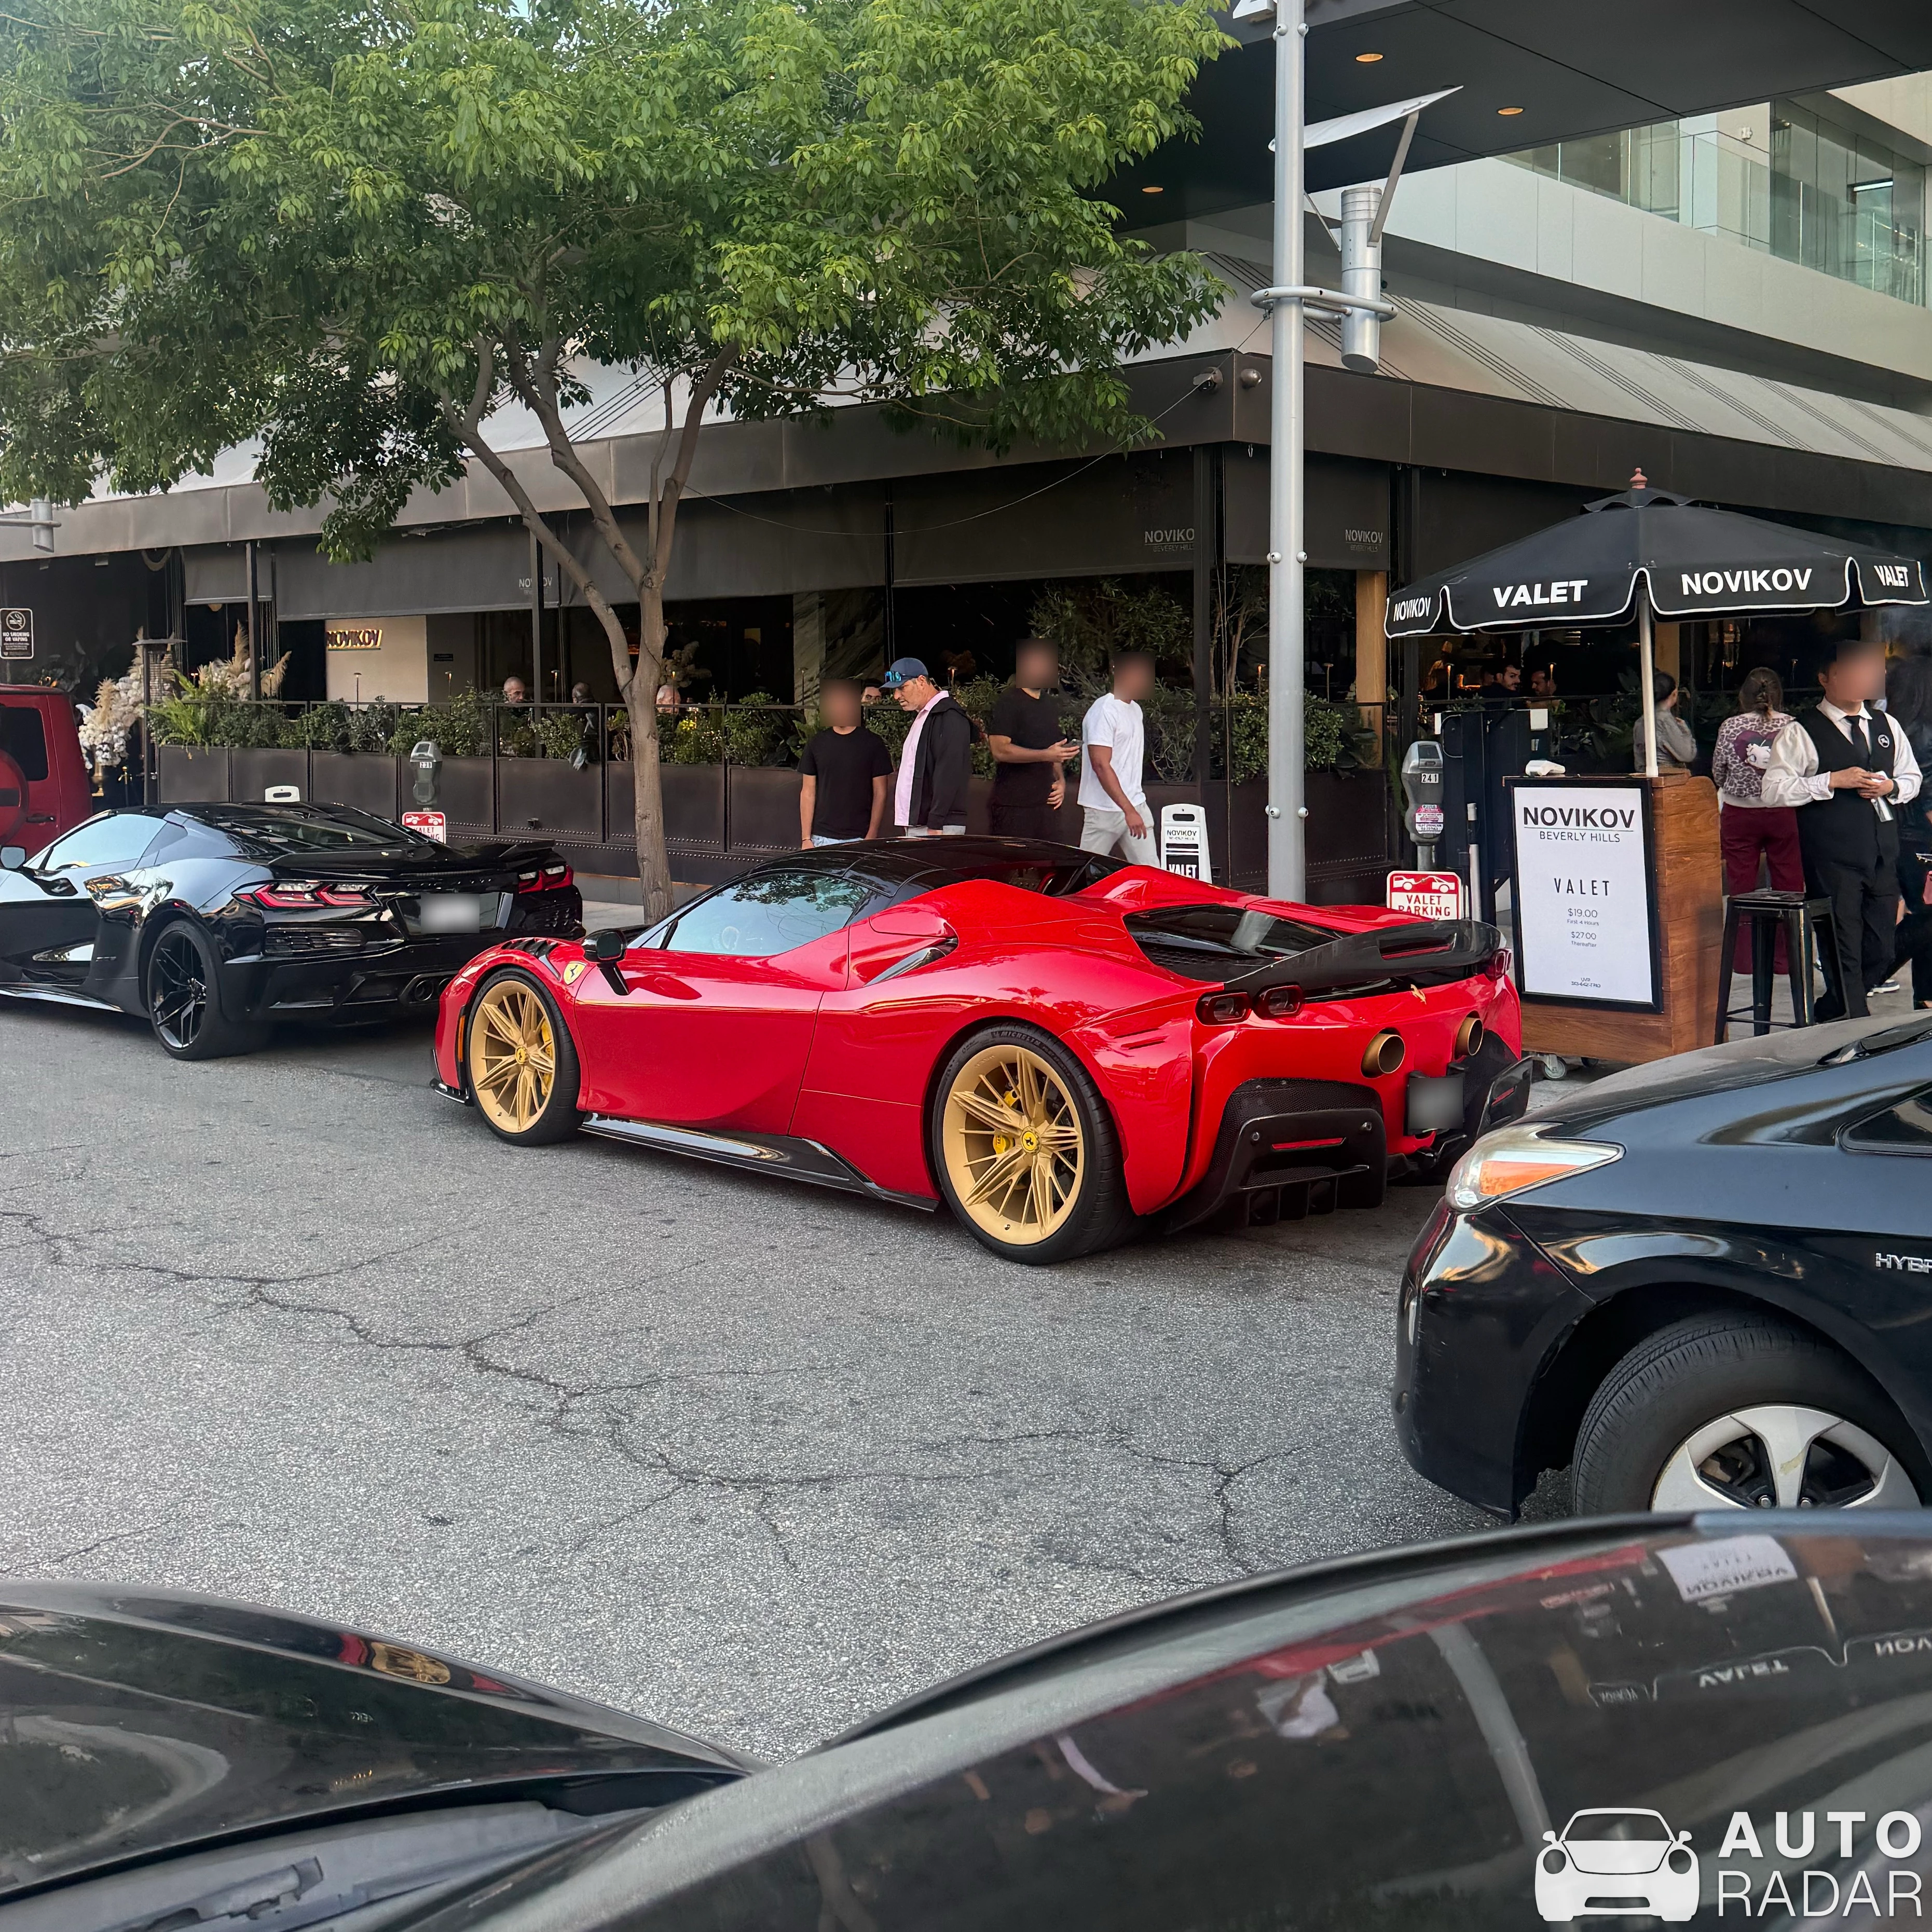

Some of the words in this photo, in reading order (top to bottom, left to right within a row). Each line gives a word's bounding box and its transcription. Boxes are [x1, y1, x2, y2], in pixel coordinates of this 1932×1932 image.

[1145, 528, 1195, 543] NOVIKO
[1345, 529, 1383, 543] NOVIKOV
[519, 577, 552, 587] NOOV
[1681, 568, 1812, 595] NOVIKOV
[1873, 565, 1909, 587] VALET
[1493, 580, 1588, 608] VALET
[1393, 597, 1431, 622] NOVIKOV
[327, 629, 382, 648] NOVIKOV
[1422, 774, 1437, 783] 241
[1524, 807, 1635, 828] NOVIKOV
[1540, 831, 1586, 841] BEVERLY
[1591, 833, 1620, 842] HILLS
[1169, 864, 1197, 879] VALET
[1554, 878, 1610, 896] VALET
[1406, 895, 1442, 905] VALET
[1398, 905, 1450, 916] PARKING
[1568, 908, 1598, 918] $19.00
[1571, 931, 1596, 940] $2700
[1000, 1031, 1042, 1047] MICHELIN
